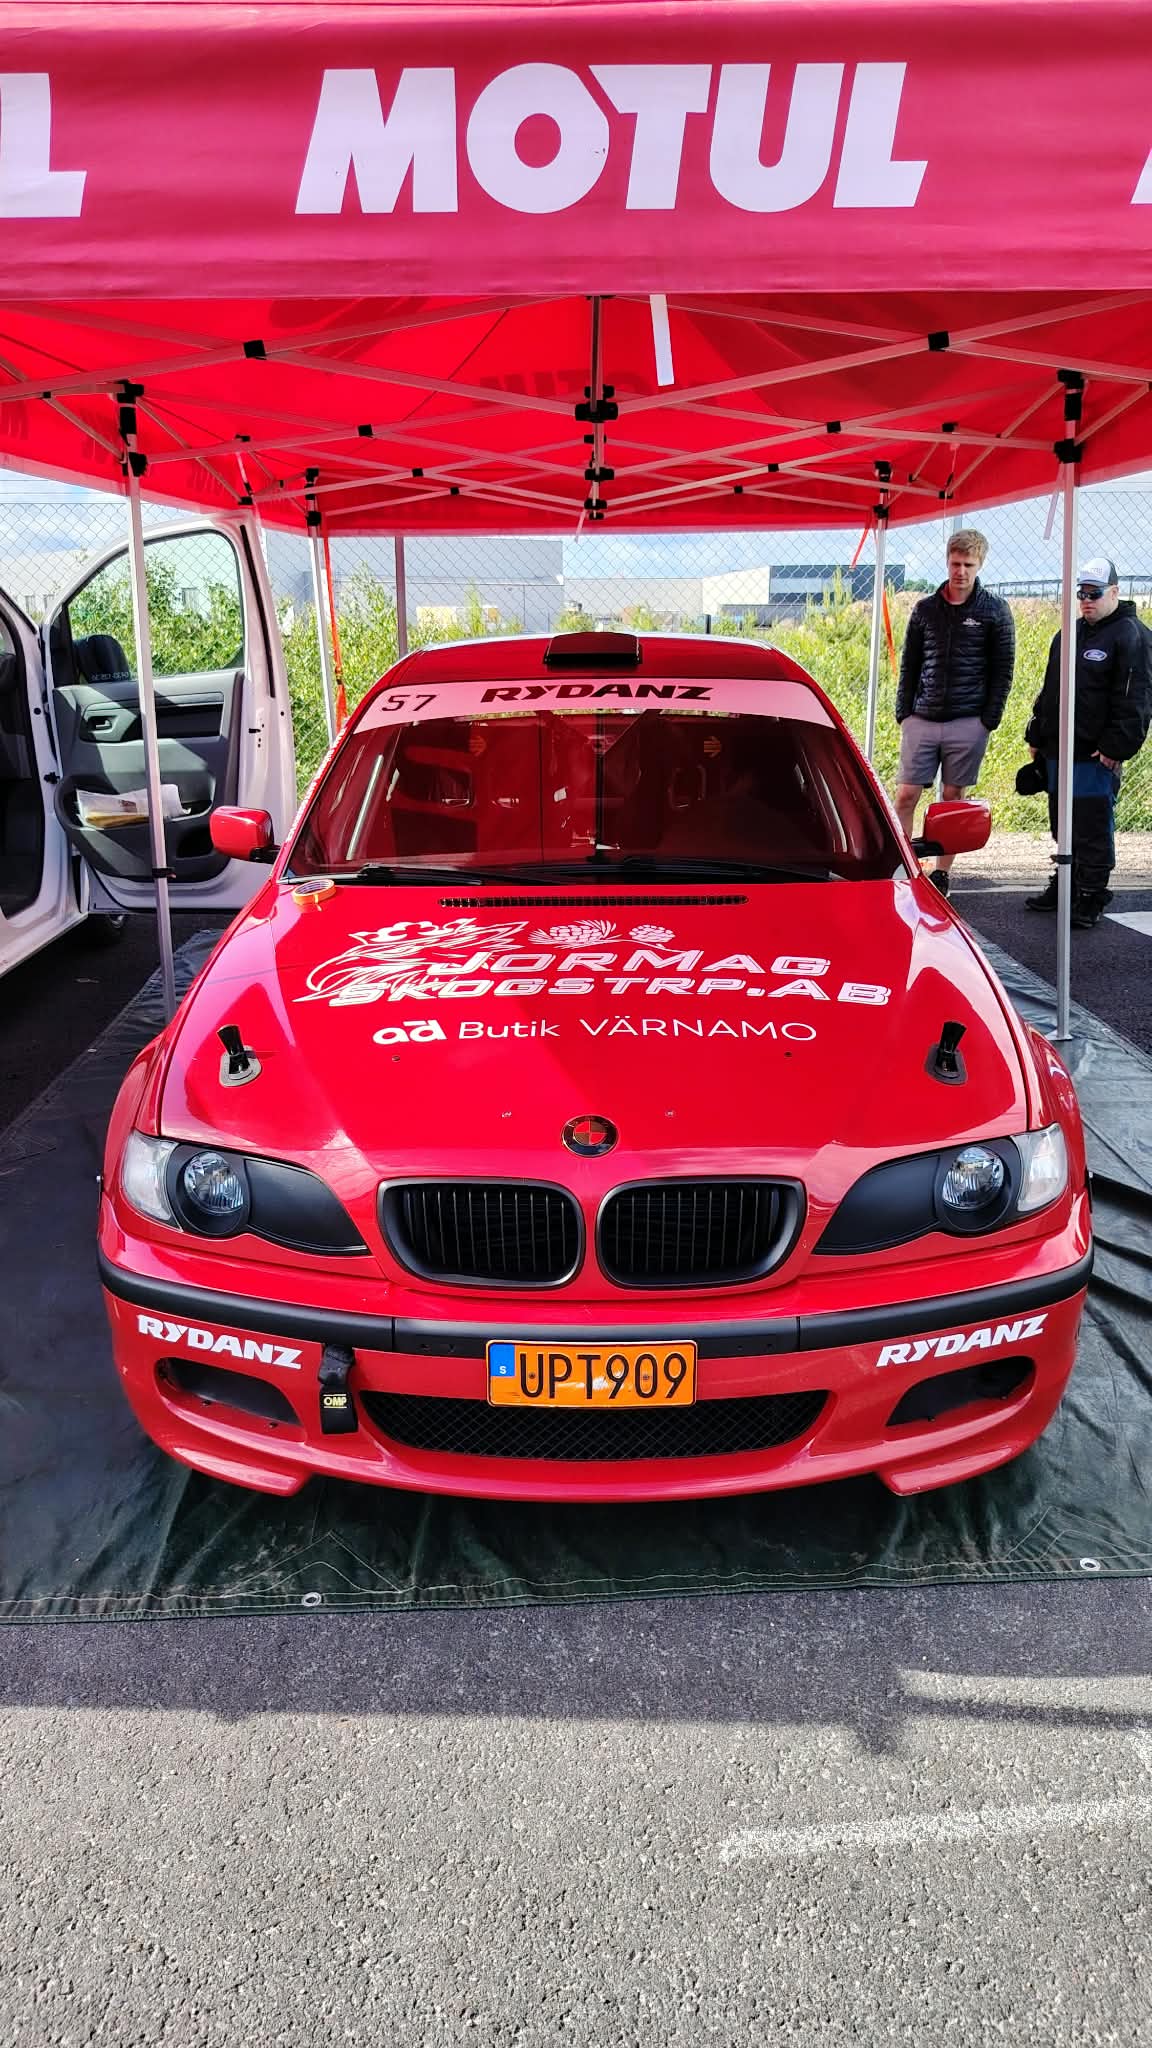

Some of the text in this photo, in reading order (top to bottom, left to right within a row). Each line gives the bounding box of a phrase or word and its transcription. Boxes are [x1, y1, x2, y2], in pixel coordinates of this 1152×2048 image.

[295, 62, 928, 215] MOTUL
[381, 694, 439, 712] 57
[480, 684, 715, 703] RYDANZ
[458, 1019, 560, 1040] Butik
[579, 1015, 817, 1041] VÄRNAMO
[136, 1314, 303, 1370] RYDANZ
[876, 1313, 1049, 1368] RYDANZ
[499, 1352, 688, 1400] S UPT909
[323, 1394, 347, 1408] OMP
